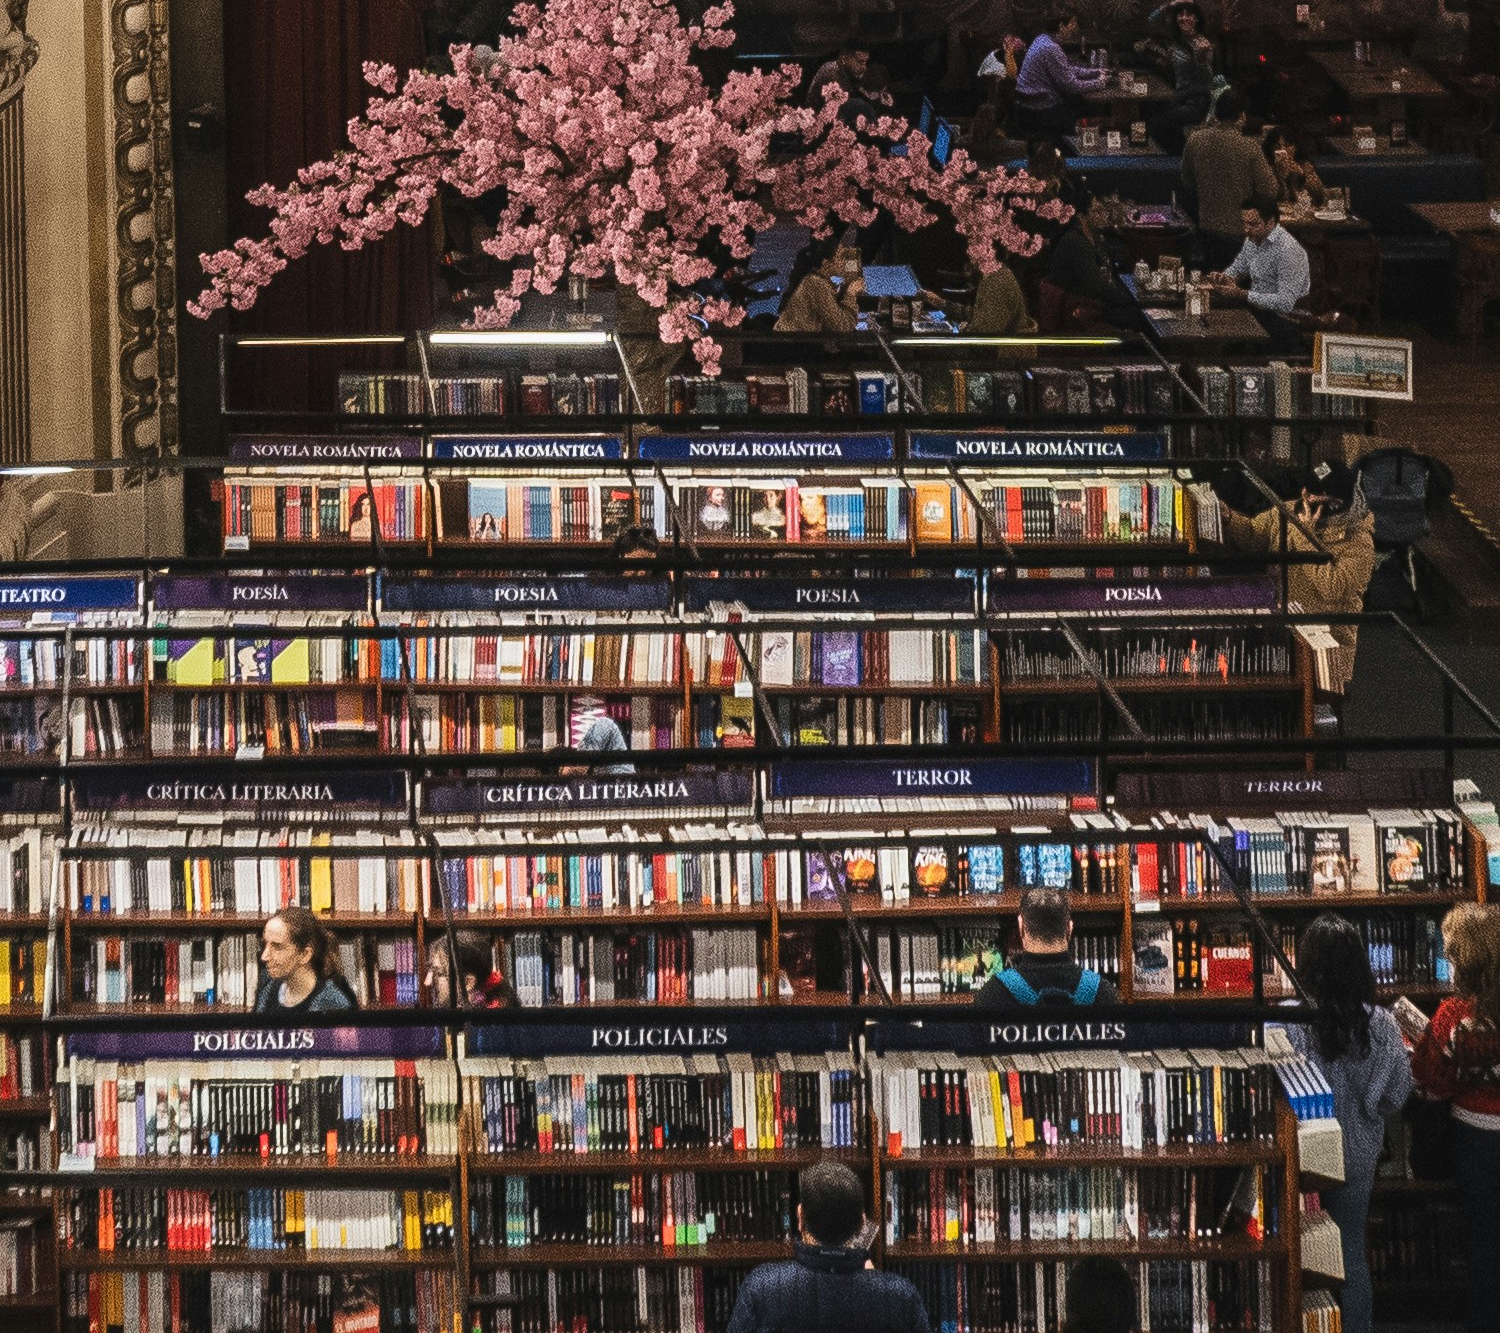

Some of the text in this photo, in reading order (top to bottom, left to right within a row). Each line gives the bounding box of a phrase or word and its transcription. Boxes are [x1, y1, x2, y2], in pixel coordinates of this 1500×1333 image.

[250, 443, 403, 459] NOVELA ROMÁNTICA
[452, 442, 606, 459] NOVELA ROMÁNTICA
[689, 441, 843, 457] NOVELA ROMÁNTICA
[955, 439, 1125, 456] NOVELA ROMÁNTICA
[232, 584, 289, 601] POESÍA
[494, 588, 559, 602] POESIA
[796, 588, 860, 603] POESIA
[1105, 585, 1163, 602] POESÍA
[892, 769, 973, 786] TERROR
[146, 781, 335, 801] CRÍTICA LITERARIA
[486, 782, 690, 804] CRÍTICA LITERARIA
[1245, 780, 1324, 793] TERROR
[192, 1029, 315, 1052] POLICIALES
[591, 1027, 728, 1048] POLICIALES
[989, 1022, 1127, 1044] POLICIALES
